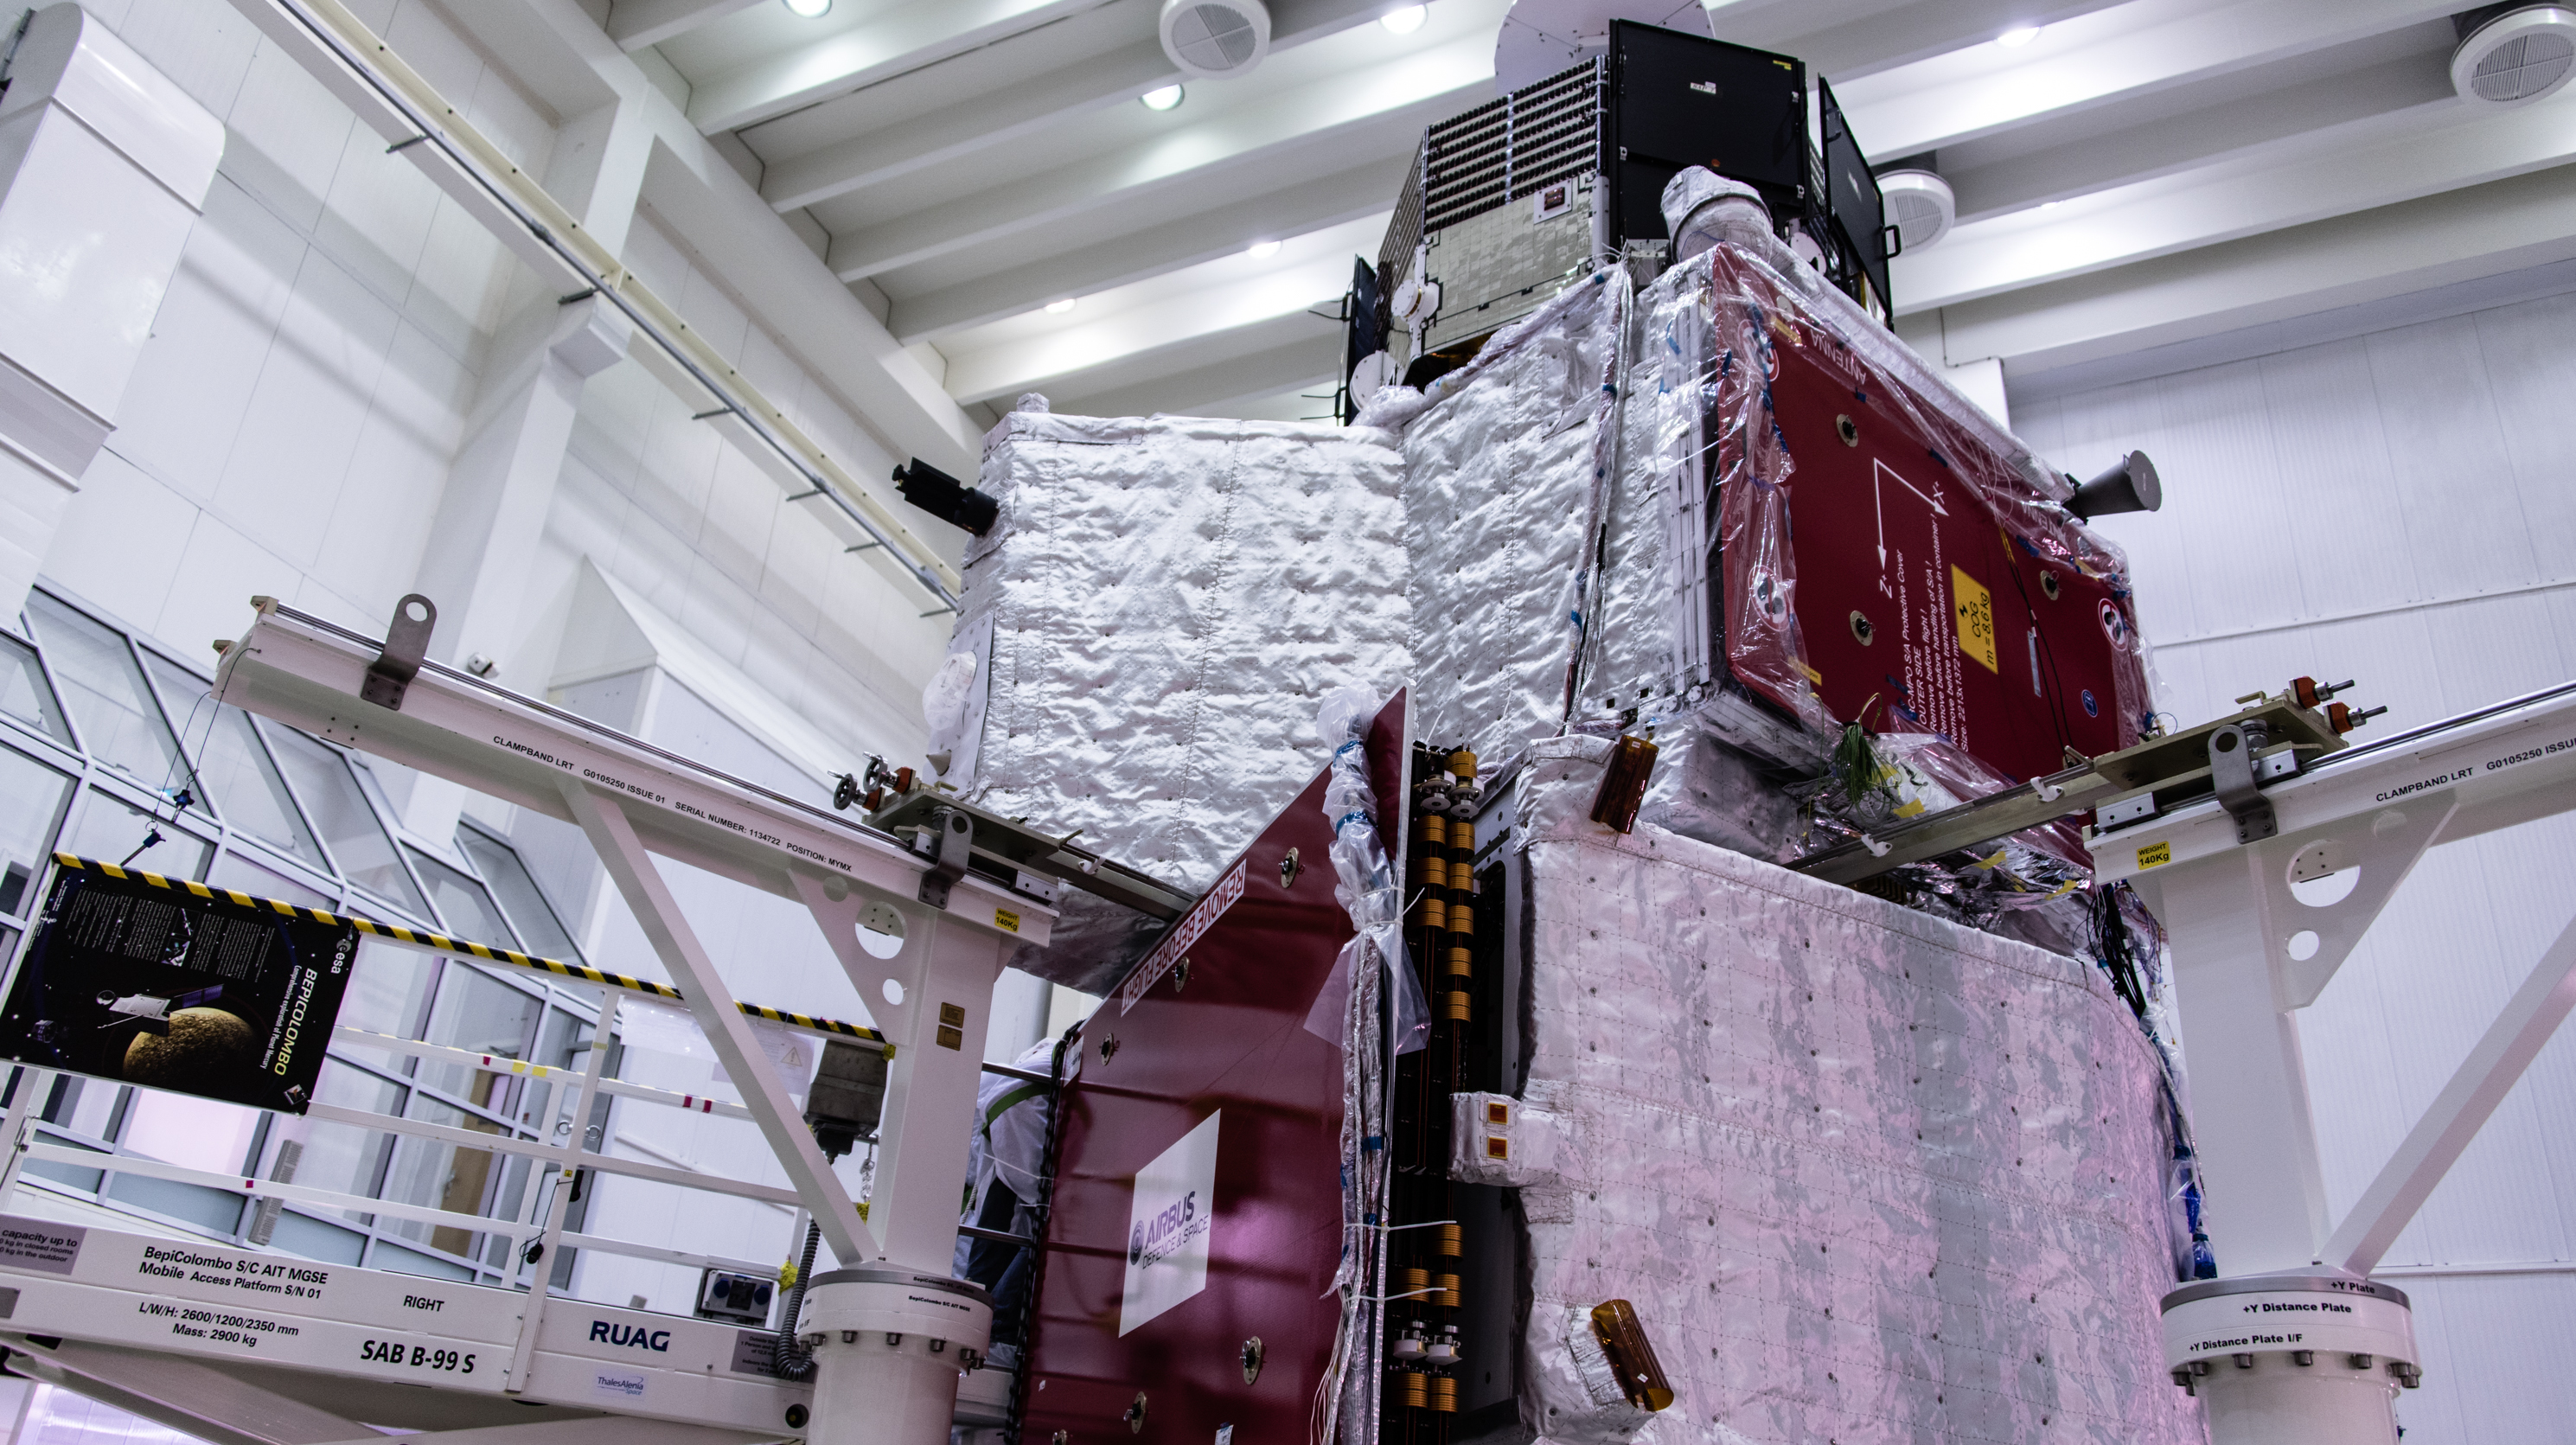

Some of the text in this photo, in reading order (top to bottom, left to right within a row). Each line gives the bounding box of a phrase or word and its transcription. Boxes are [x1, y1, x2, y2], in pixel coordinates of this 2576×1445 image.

[1810, 329, 1867, 385] ANTENNA
[1932, 520, 1942, 569] container
[1926, 569, 1934, 588] S/A
[1936, 571, 1943, 582] in
[1927, 588, 1935, 602] of
[1896, 549, 1916, 713] C-MPO S/A Protective Cover
[1921, 615, 1930, 643] flight
[1930, 604, 1940, 650] handling
[1938, 584, 1950, 657] transportation
[1969, 601, 1981, 638] COG
[1980, 591, 1994, 665] m = 8,6 kg
[1924, 646, 1934, 682] before
[1934, 653, 1944, 689] before
[1945, 660, 1954, 696] before
[1913, 646, 1927, 725] OUTER SIDE
[1952, 636, 1969, 752] Size: 2213x1372 mm
[1927, 684, 1938, 732] Remove
[1938, 691, 1948, 735] Remove
[1948, 698, 1959, 745] Remove
[2375, 774, 2449, 802] CLAMPBAND
[2451, 767, 2473, 781] LRT
[2486, 748, 2542, 770] G0105250
[493, 735, 853, 873] CLAMPBAND LRT G0105250 ISSUE 01 SERIAL NUMBER: 1134722 POSITION: MYMX
[2138, 843, 2167, 856] WEIGHT
[2139, 853, 2170, 866] 140Kg
[996, 917, 1018, 932] 140Kg
[997, 909, 1019, 921] WEIGHT
[1122, 863, 1244, 1012] REMOVE BEFORE FLIGHT
[330, 952, 346, 975] esa
[284, 965, 301, 1000] Comprehensive
[274, 968, 318, 1076] BEPICOLOMBO
[275, 1000, 288, 1026] exploration
[268, 1033, 278, 1048] Planet
[259, 1048, 273, 1069] Mercury
[1145, 1191, 1196, 1250] AIRBUS
[2, 1230, 78, 1247] capacity up to
[4, 1238, 15, 1247] kg
[24, 1243, 49, 1251] closed
[5, 1247, 16, 1256] kg
[38, 1253, 67, 1263] outdoor
[1142, 1214, 1208, 1269] DEFENCE & SPACE
[138, 1262, 321, 1299] Mobile Access Platform S/N 01
[144, 1246, 329, 1284] BepiColombo S/C AIT MGSE
[913, 1276, 946, 1286] BepiColombo
[403, 1295, 444, 1312] RIGHT
[909, 1295, 941, 1305] BepiColombo
[2330, 1281, 2375, 1294] +Y Plate
[138, 1302, 299, 1336] L/W/H: 2600/1200/2350 mm
[2243, 1302, 2352, 1314] +Y Distance Plate
[172, 1323, 258, 1348] Mass: 2900 kg
[589, 1320, 671, 1352] RUAG
[2189, 1333, 2303, 1352] +Y Distance Plate I/F
[360, 1340, 476, 1373] SAB B-99 S
[598, 1376, 644, 1391] ThalesAlenia
